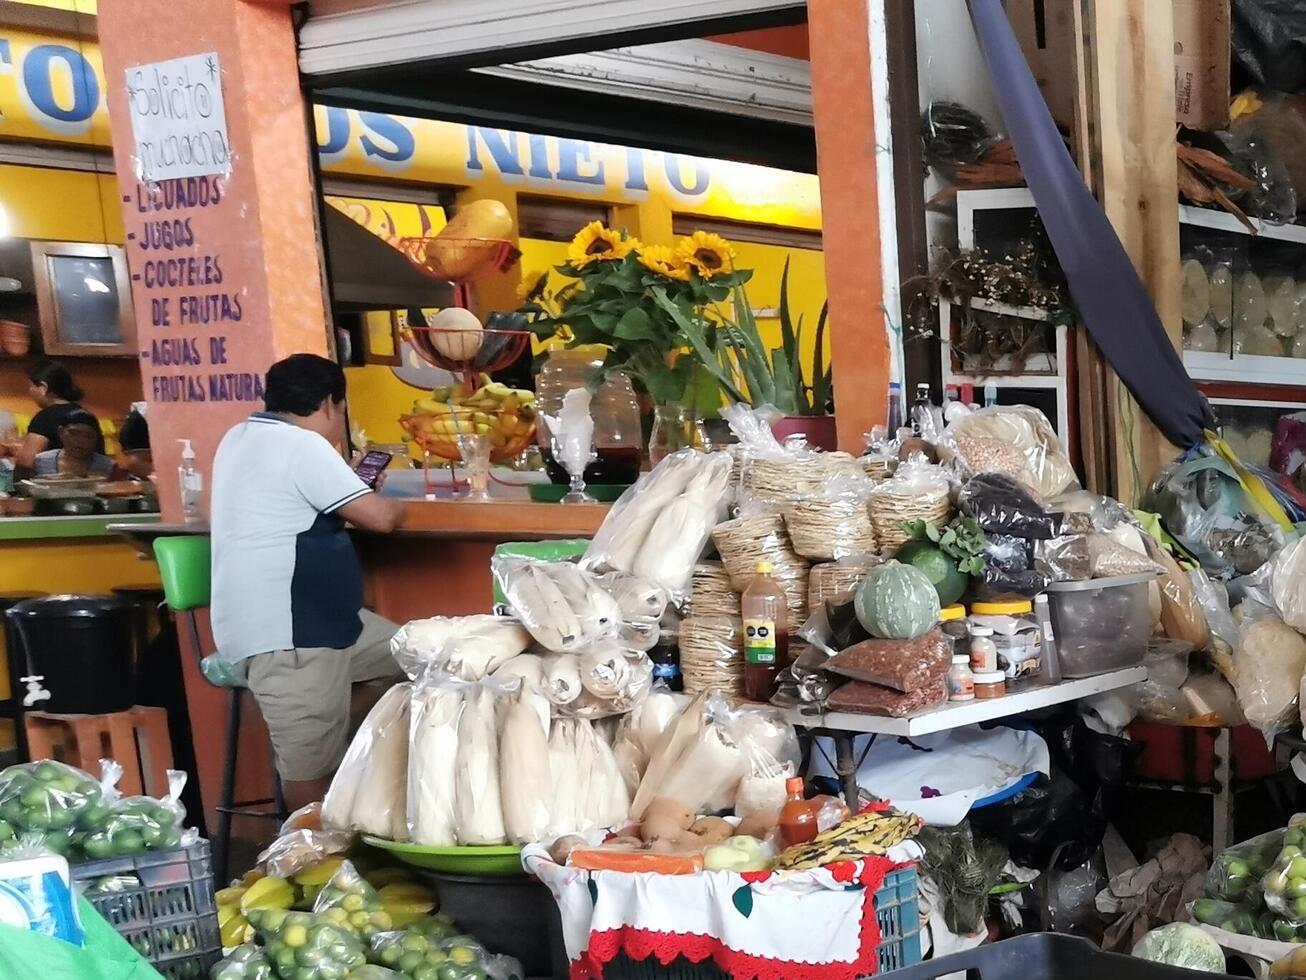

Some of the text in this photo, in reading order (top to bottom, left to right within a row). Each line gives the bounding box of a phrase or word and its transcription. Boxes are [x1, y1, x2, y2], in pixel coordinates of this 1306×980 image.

[152, 293, 242, 326] DE FRUTAS
[209, 336, 227, 364] DE
[152, 374, 206, 402] FRUTAS
